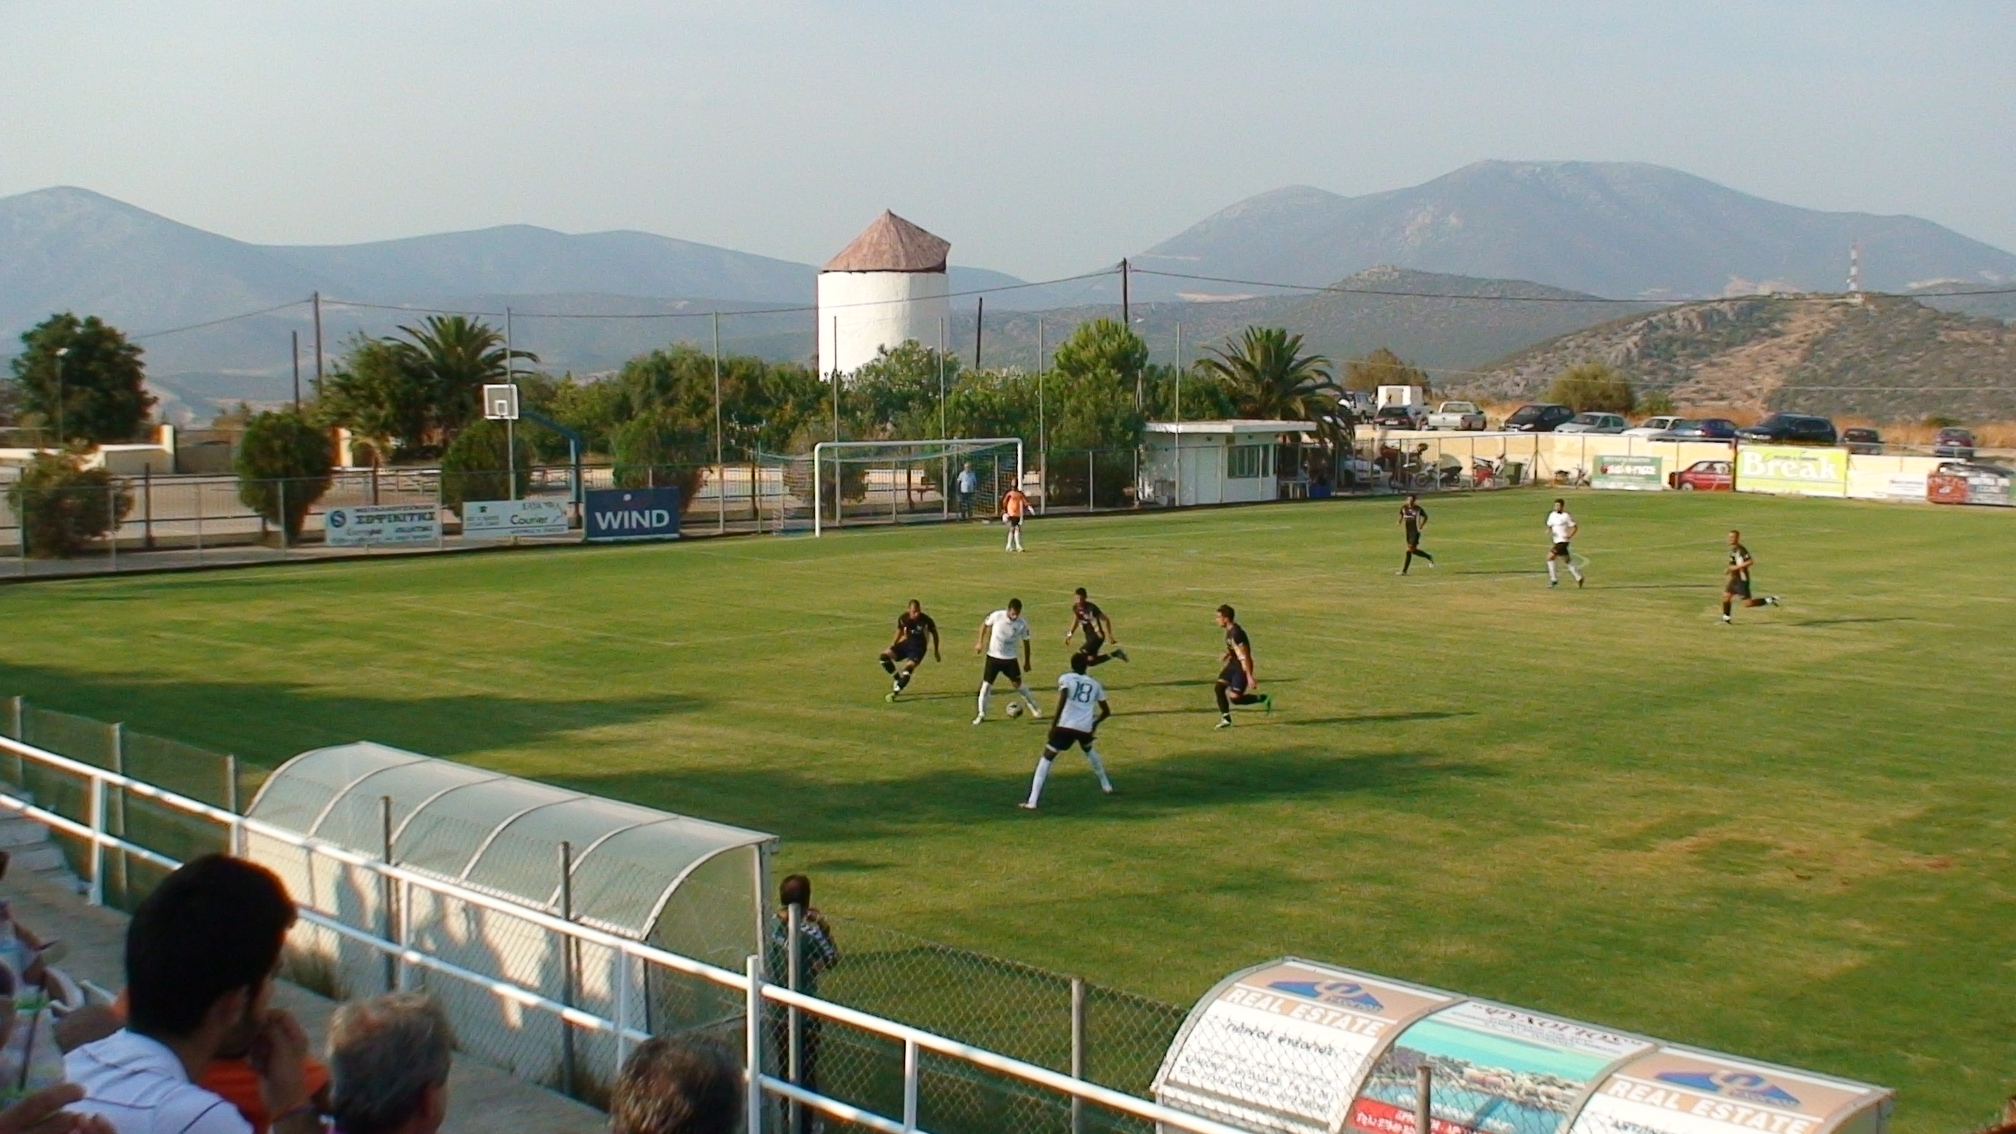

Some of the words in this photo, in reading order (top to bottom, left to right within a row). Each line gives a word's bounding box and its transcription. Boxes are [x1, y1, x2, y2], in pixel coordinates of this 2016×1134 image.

[1742, 451, 1836, 479] Break
[511, 514, 547, 525] Courier
[595, 509, 670, 530] WIND
[1072, 681, 1093, 703] 18
[1226, 988, 1285, 1013] REAL
[1289, 1003, 1385, 1036] ESTATE
[1607, 1080, 1680, 1110] REAL
[1689, 1100, 1809, 1134] ESTATE
